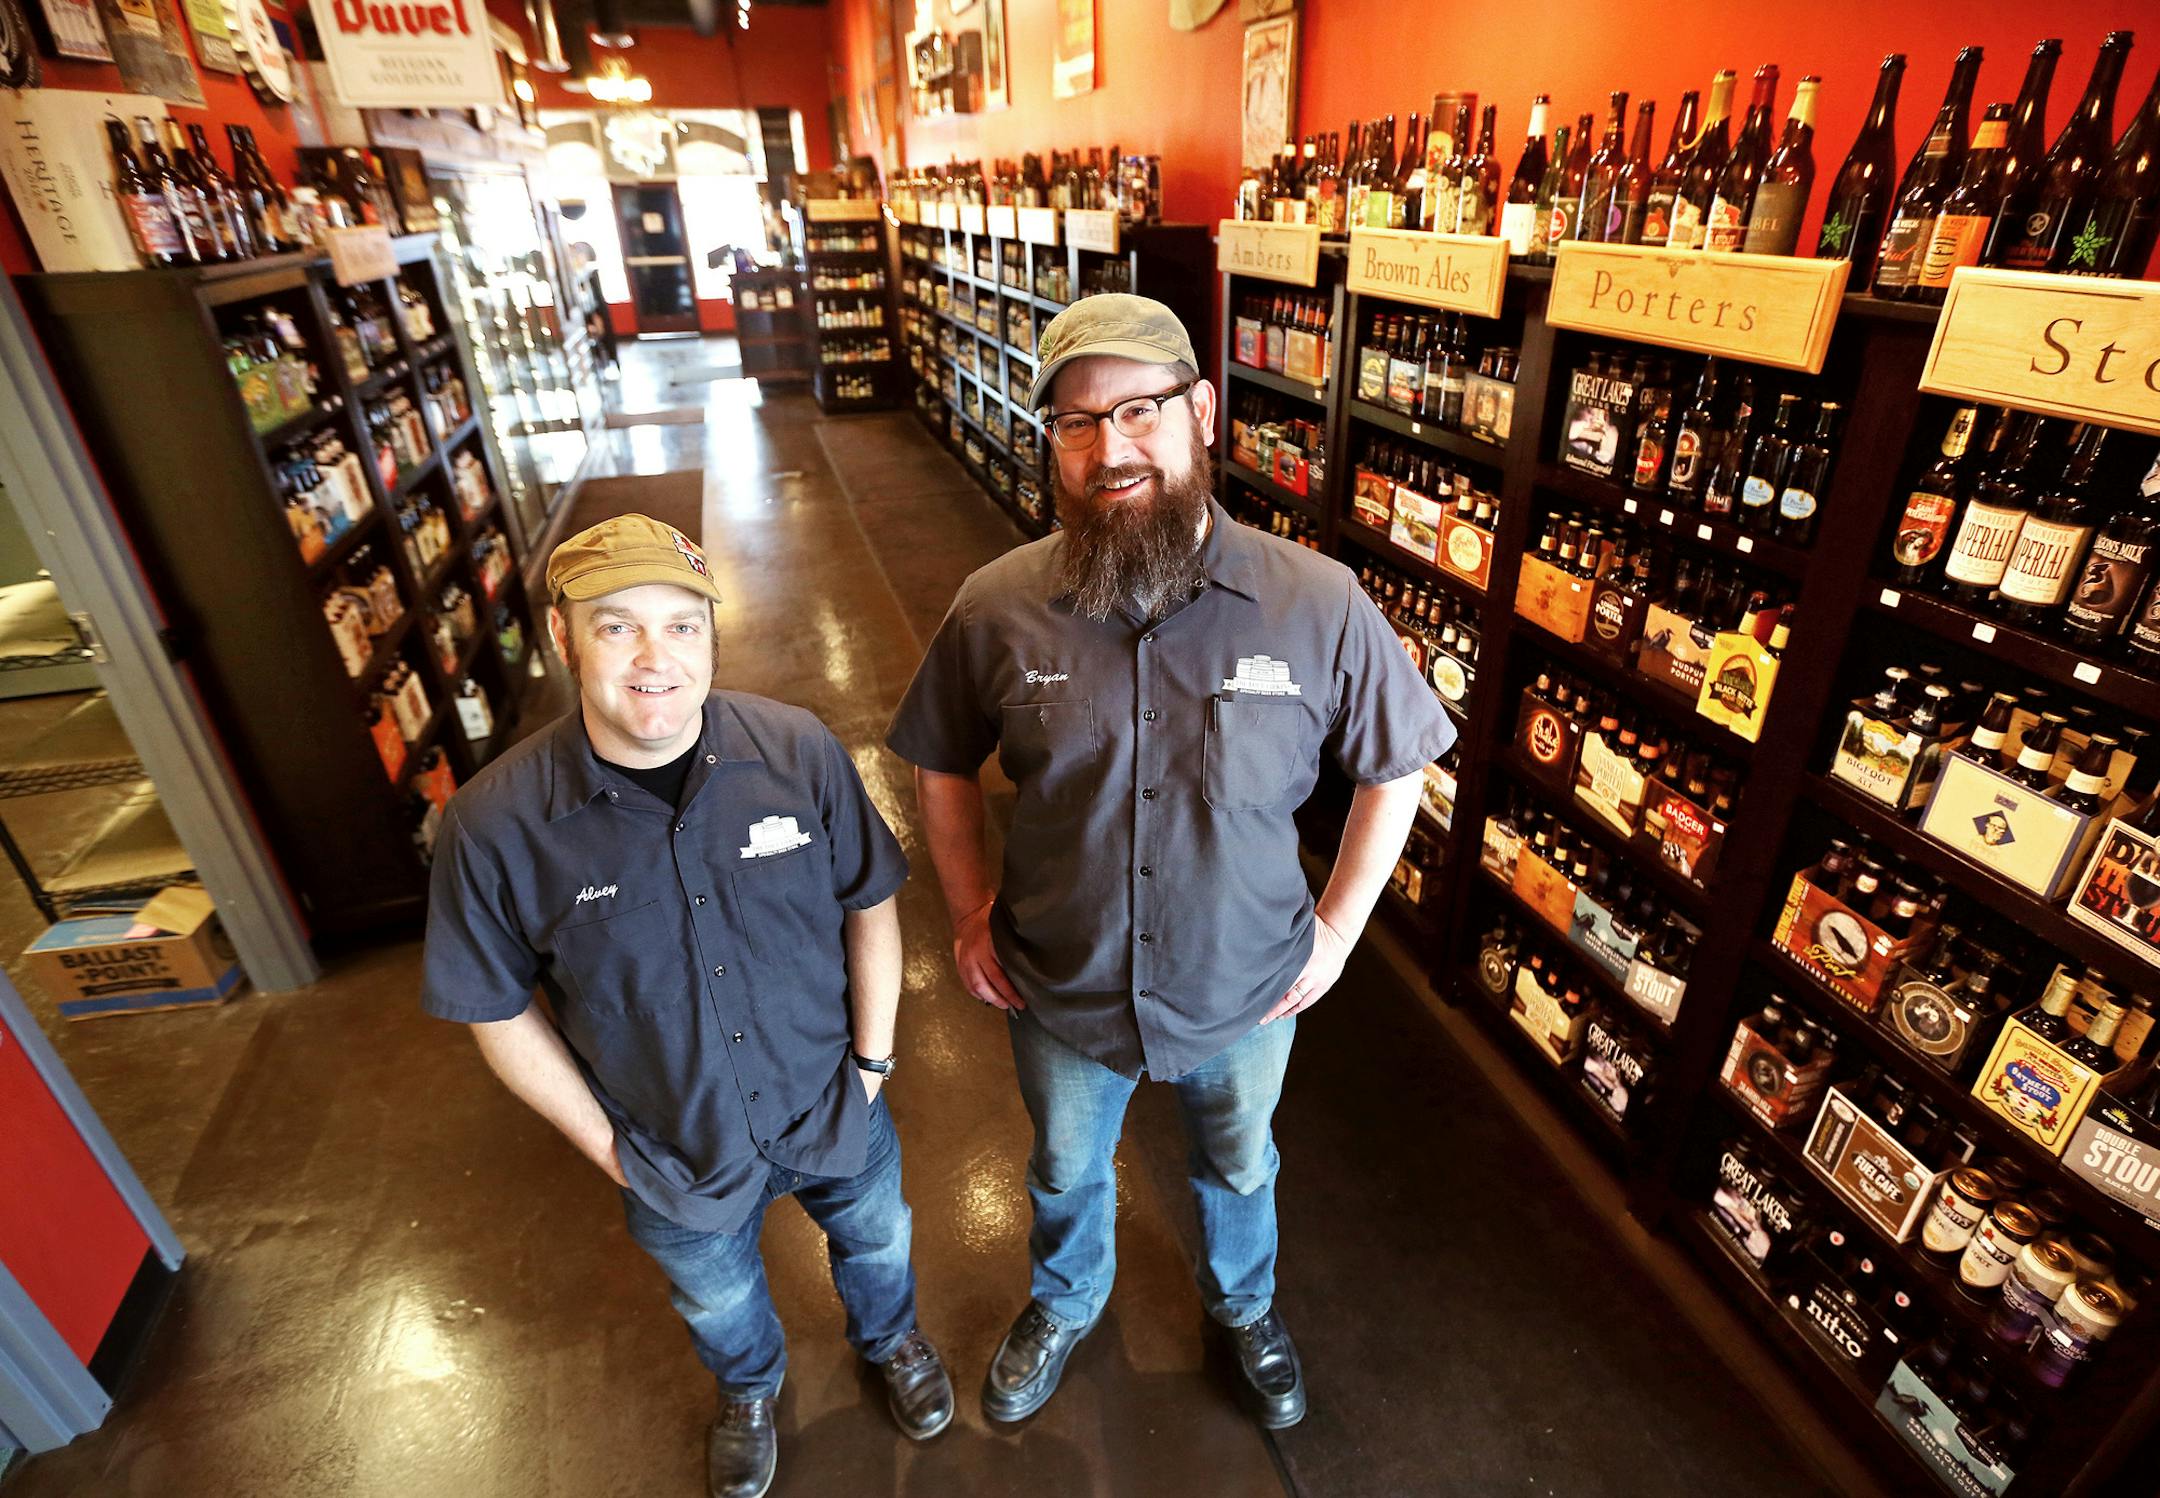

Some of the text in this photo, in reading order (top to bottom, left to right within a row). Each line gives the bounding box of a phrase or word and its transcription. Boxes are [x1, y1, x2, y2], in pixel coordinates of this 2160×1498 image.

[333, 0, 471, 37] Duvel
[1231, 238, 1294, 270] Ambers
[1364, 247, 1470, 294] Brown Ales
[1590, 271, 1758, 333] Porters
[1572, 372, 1603, 399] GREAT
[2119, 543, 2146, 564] MILK
[1595, 603, 1624, 626] PORTER
[1024, 669, 1070, 689] Bryan
[1670, 666, 1700, 687] PORTER
[1714, 682, 1738, 696] BLACK
[1846, 757, 1893, 786] BIGFOOT
[1858, 775, 1874, 789] ALE
[1665, 803, 1705, 836] BADGER
[574, 883, 619, 905] Alvey
[58, 945, 164, 969] BALLAST
[86, 962, 156, 981] POINT
[1790, 951, 1827, 982] HOLLAND
[1632, 973, 1676, 1007] STOUT
[1587, 1022, 1617, 1056] GREAT
[2012, 1067, 2053, 1095] OATMEAL
[2021, 1084, 2054, 1102] STOUT
[2095, 1127, 2142, 1157] DOUBLE
[1720, 1151, 1758, 1193] GREAT
[1853, 1155, 1876, 1182] FUEL
[1874, 1174, 1901, 1201] CAFE
[1806, 1299, 1863, 1358] nitro
[1905, 1422, 1977, 1497] IMPERIAL STOUT
[1908, 1417, 1988, 1498] SATIN SOLITUDE
